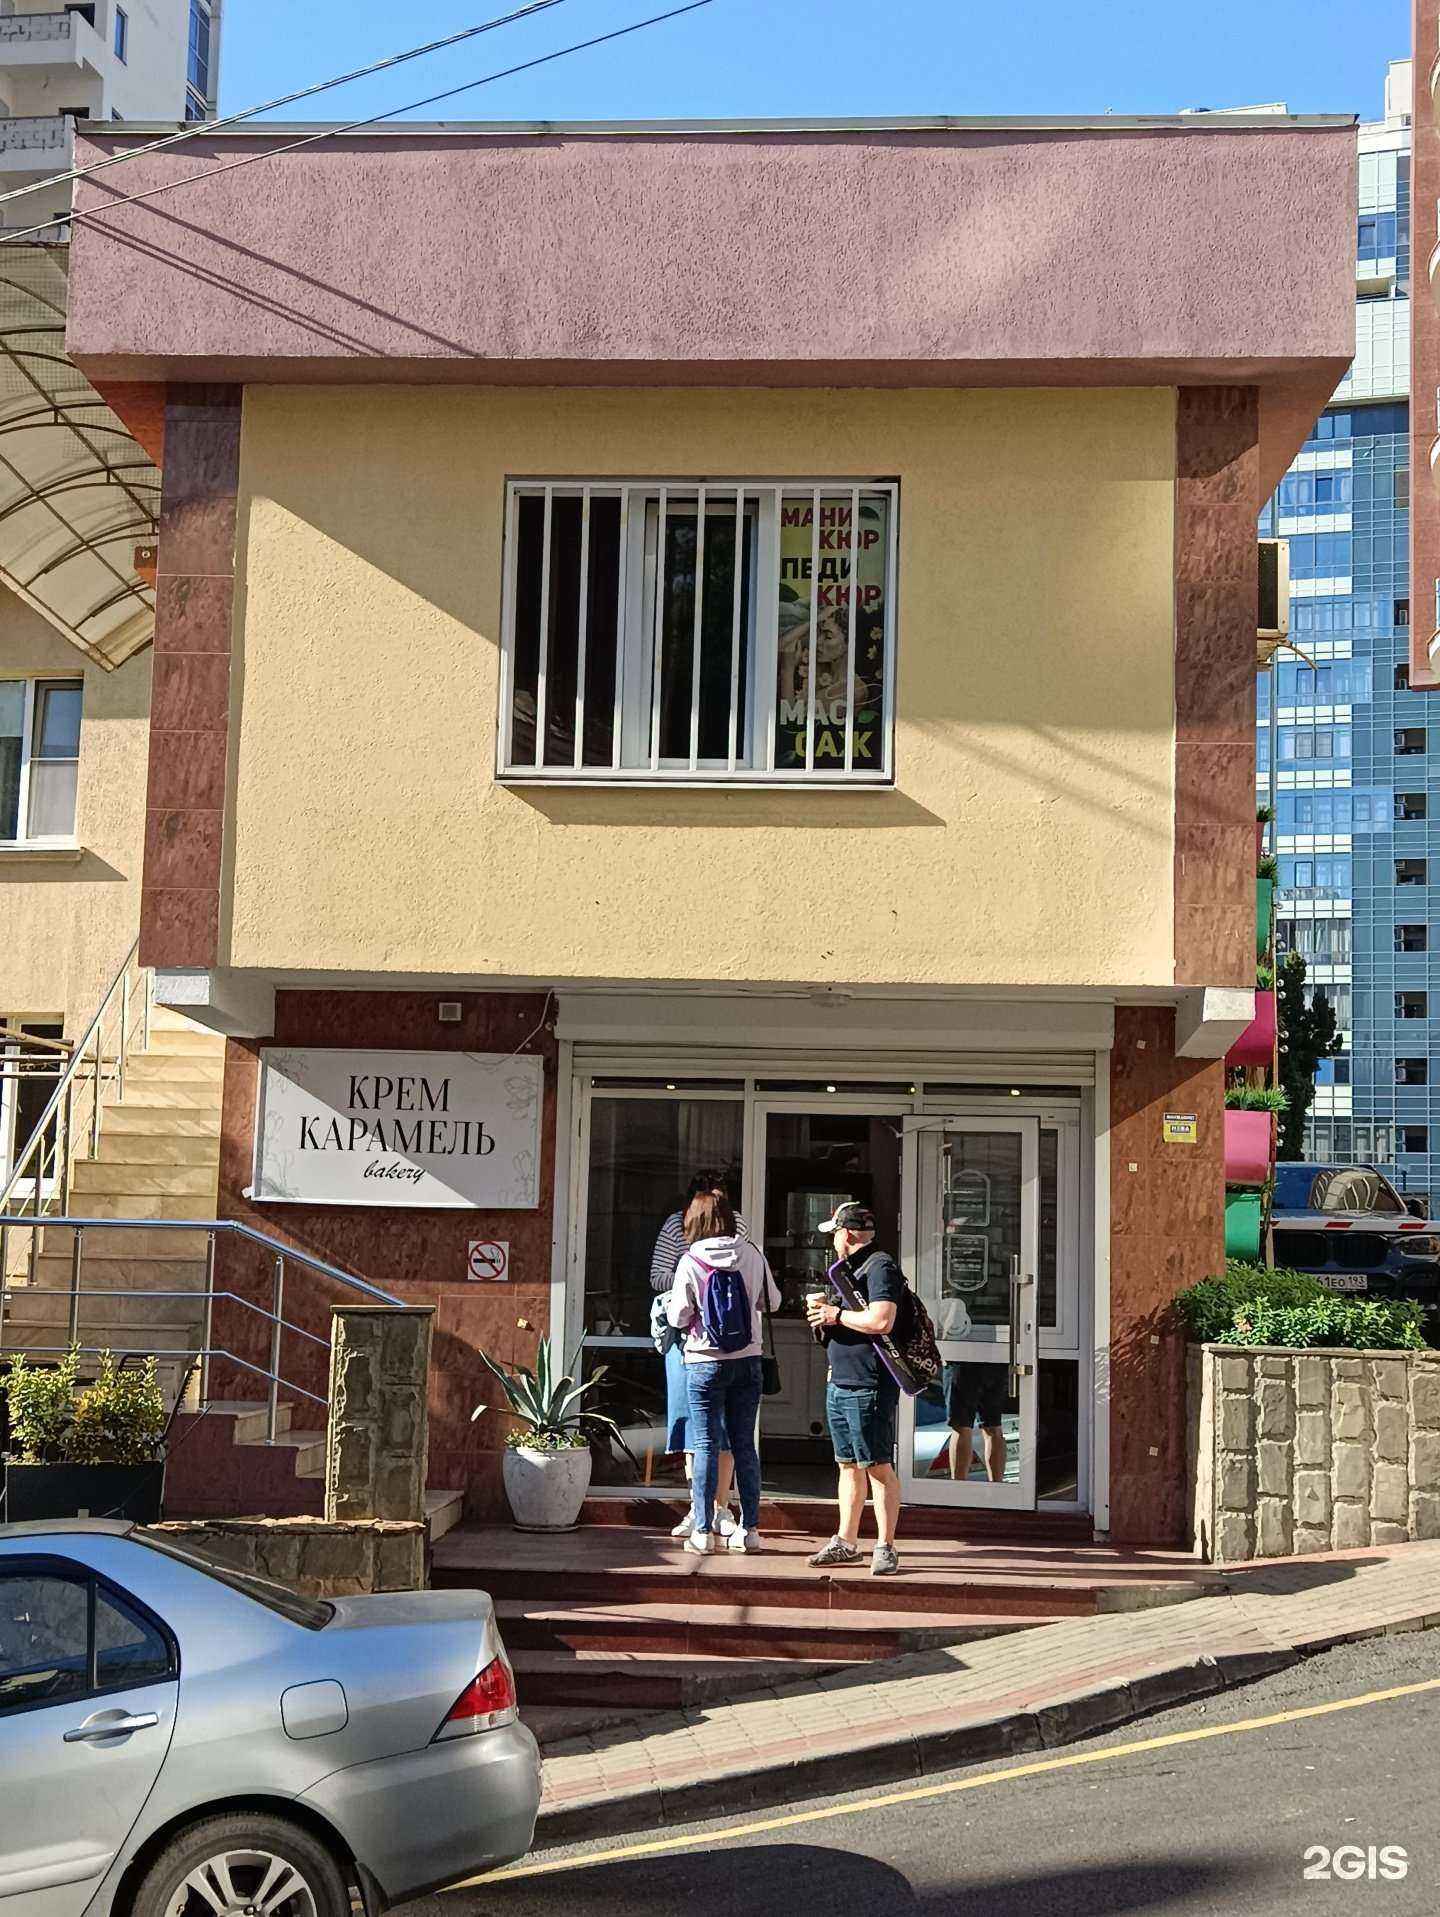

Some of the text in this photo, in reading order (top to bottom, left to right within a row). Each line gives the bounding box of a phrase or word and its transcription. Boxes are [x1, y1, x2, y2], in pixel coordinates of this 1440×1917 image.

[781, 507, 855, 527] МАНИ
[818, 529, 880, 550] КЮР
[781, 557, 858, 583] ПЕДИ
[817, 585, 882, 607] КЮР
[780, 699, 849, 726] МАС
[346, 1075, 451, 1113] КРЕМ
[299, 1115, 496, 1156] КАРАМЕЛЬ
[363, 1159, 428, 1184] bakery
